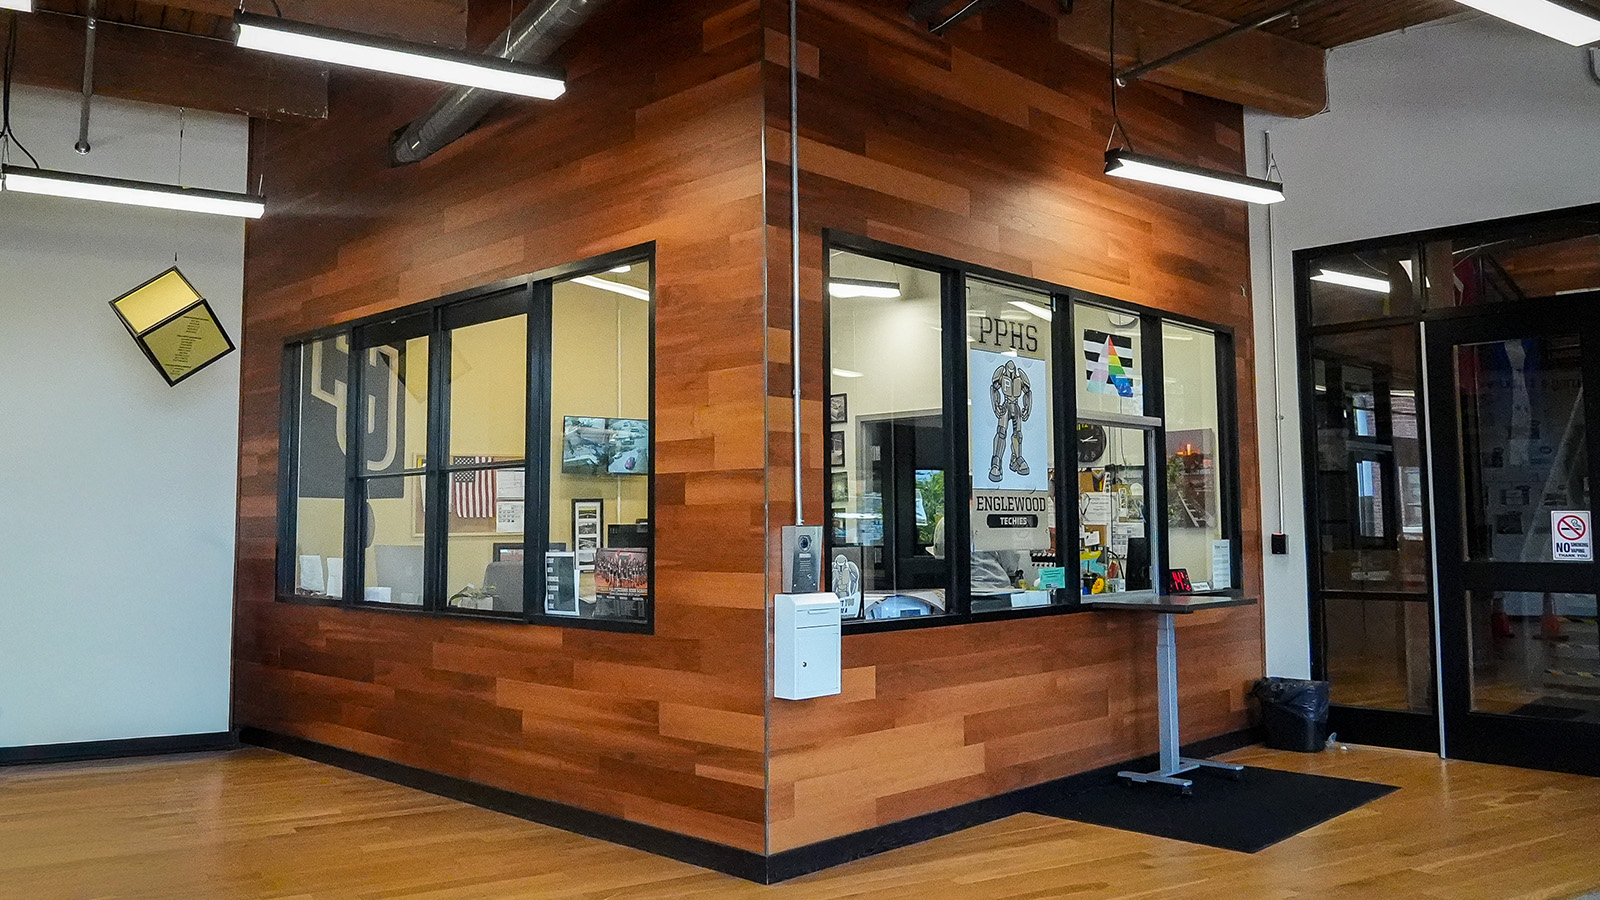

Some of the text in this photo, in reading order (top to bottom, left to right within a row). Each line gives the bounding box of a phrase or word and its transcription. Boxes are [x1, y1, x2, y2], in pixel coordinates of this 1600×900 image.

[978, 316, 1038, 352] PPHS
[976, 496, 1046, 512] ENGLEWOOD
[999, 517, 1027, 525] TECHIES
[1556, 542, 1570, 552] NO
